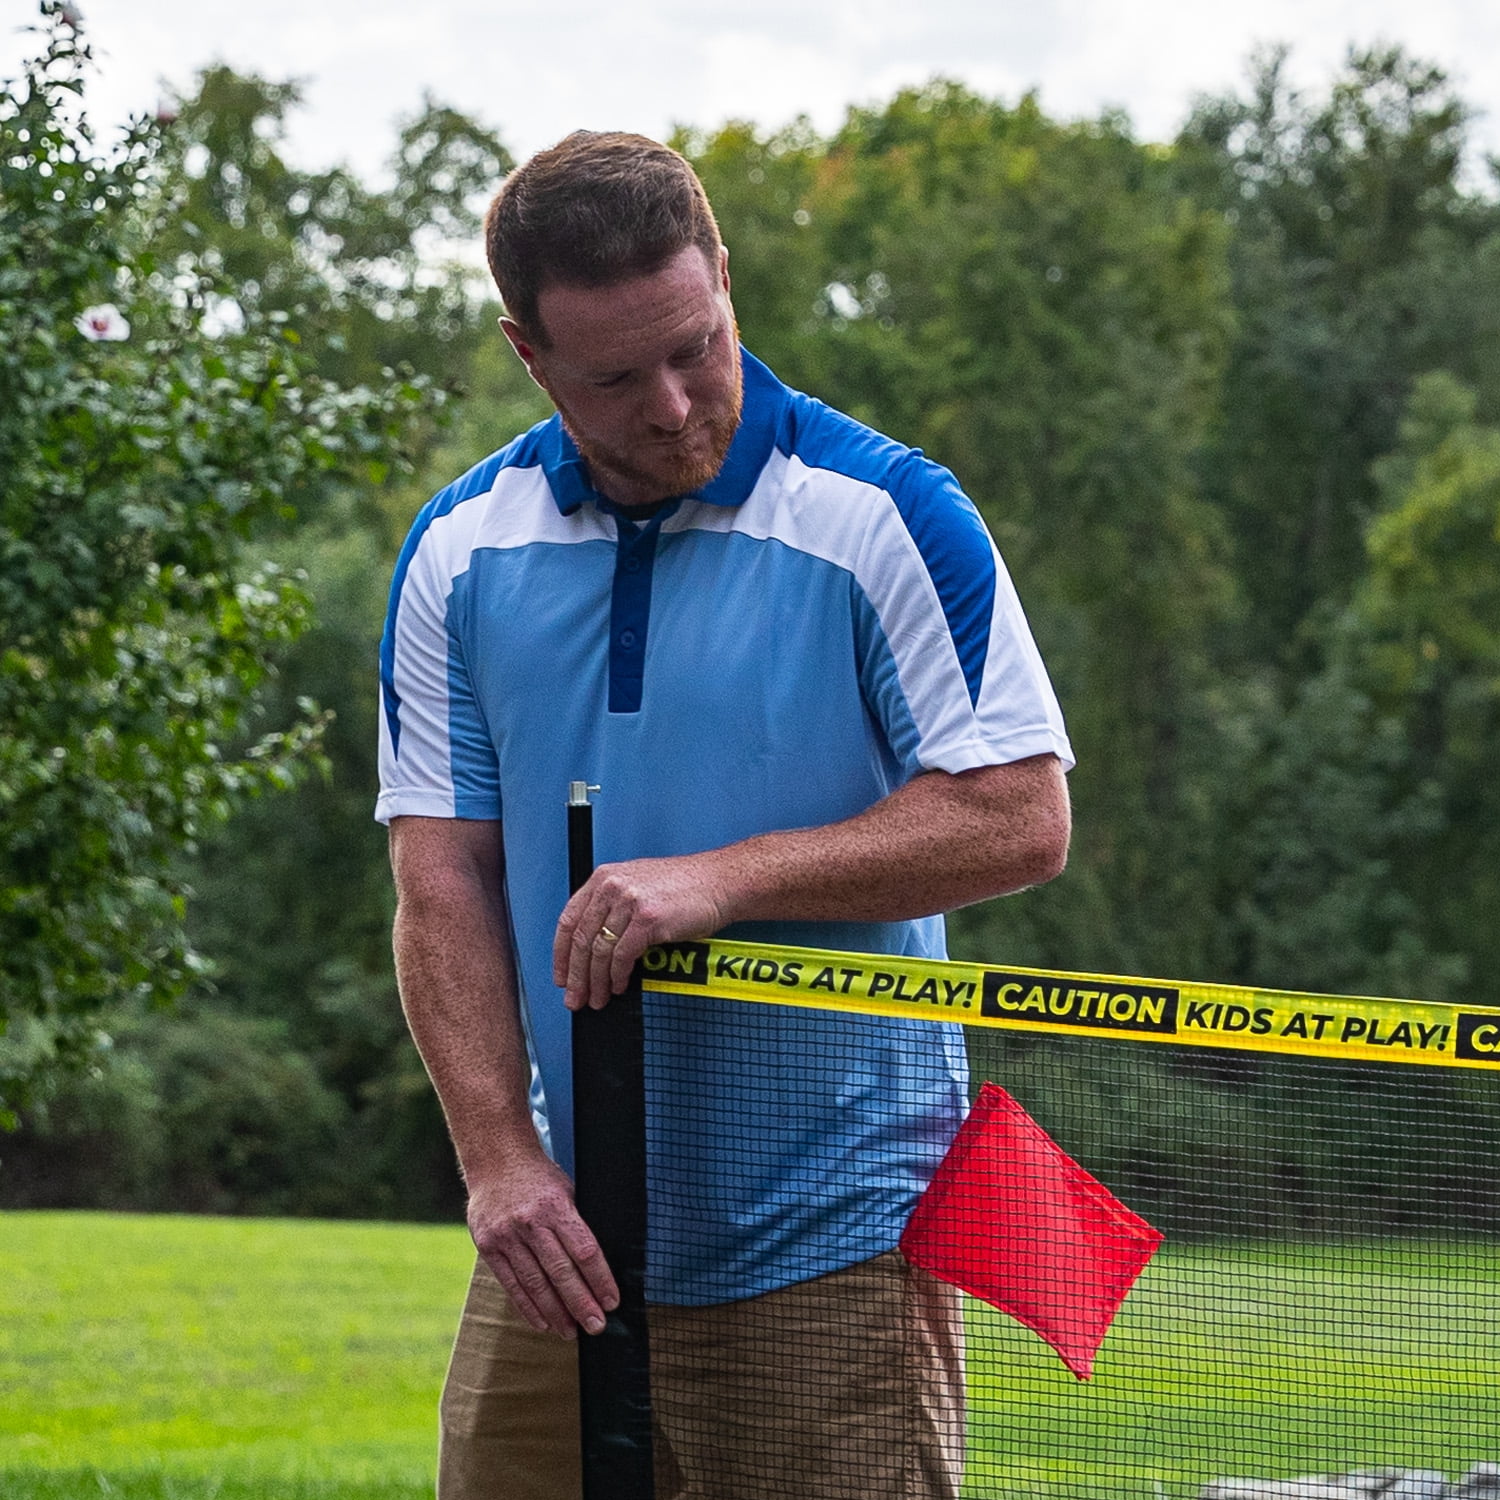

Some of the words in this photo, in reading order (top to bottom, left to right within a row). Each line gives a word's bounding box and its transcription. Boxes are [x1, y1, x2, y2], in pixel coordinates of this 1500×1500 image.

[715, 955, 804, 987] KIDS
[809, 967, 862, 994] AT
[867, 972, 977, 1008] PLAY!
[997, 983, 1167, 1023] CAUTION
[1184, 1002, 1274, 1035] KIDS
[1280, 1012, 1335, 1040] AT
[1341, 1017, 1451, 1051] PLAY!
